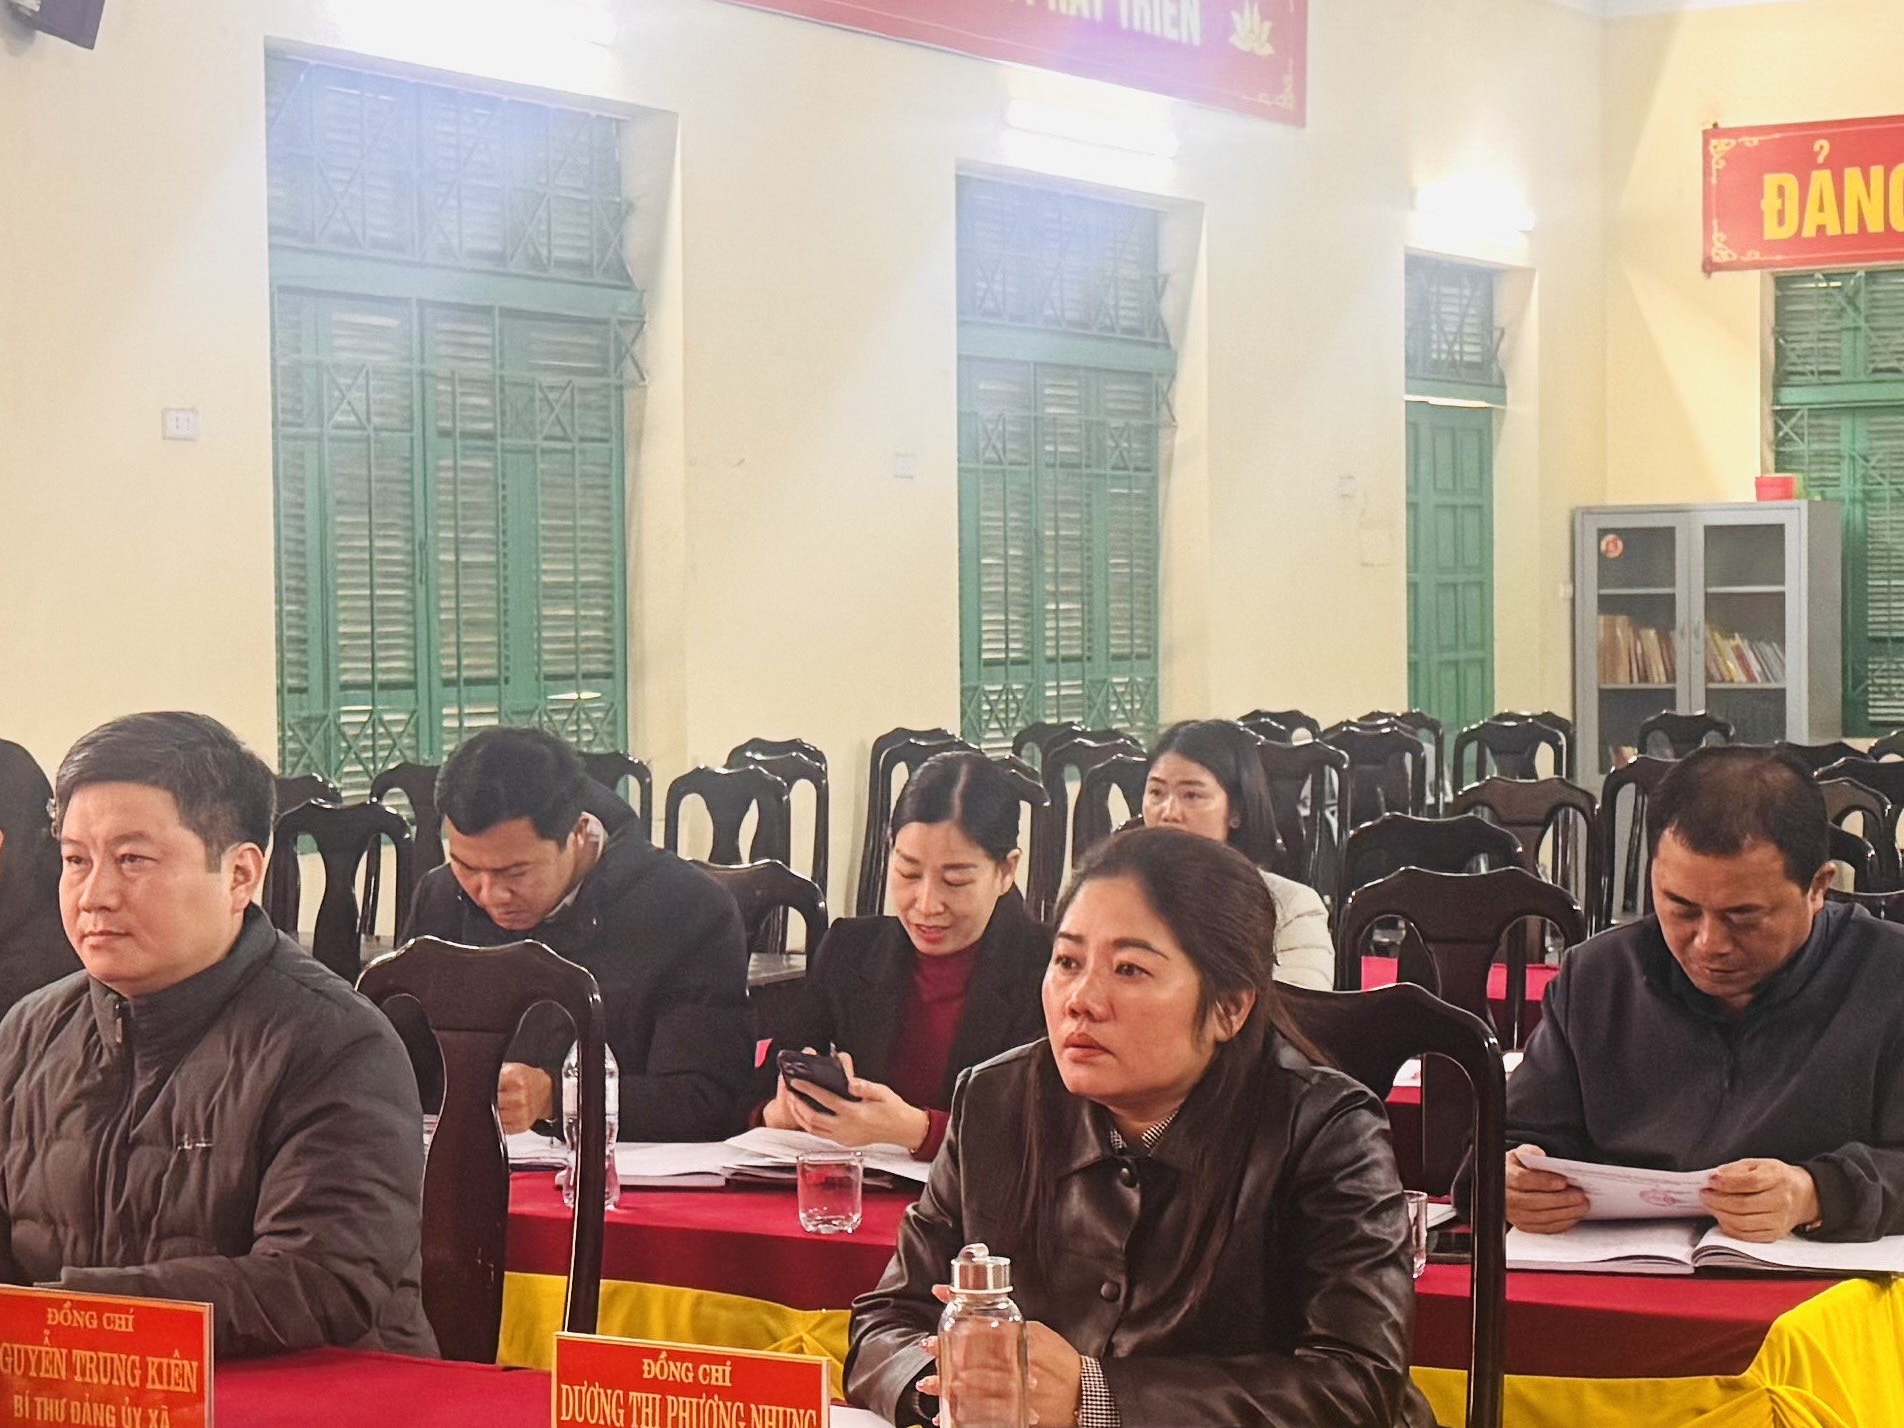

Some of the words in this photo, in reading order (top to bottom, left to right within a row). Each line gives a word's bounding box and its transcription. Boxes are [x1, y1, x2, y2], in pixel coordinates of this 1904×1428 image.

[47, 1300, 97, 1329] ĐỒNG
[102, 1308, 135, 1333] CHÍ
[71, 1349, 142, 1388] TRUNG
[146, 1348, 199, 1393] KIÊN
[642, 1350, 694, 1383] ĐỒNG
[698, 1360, 732, 1387] CHÍ
[13, 1390, 30, 1419] BÍ
[34, 1395, 68, 1422] THƯ
[70, 1392, 117, 1428] ĐẢNG
[560, 1379, 625, 1428] DƯƠNG
